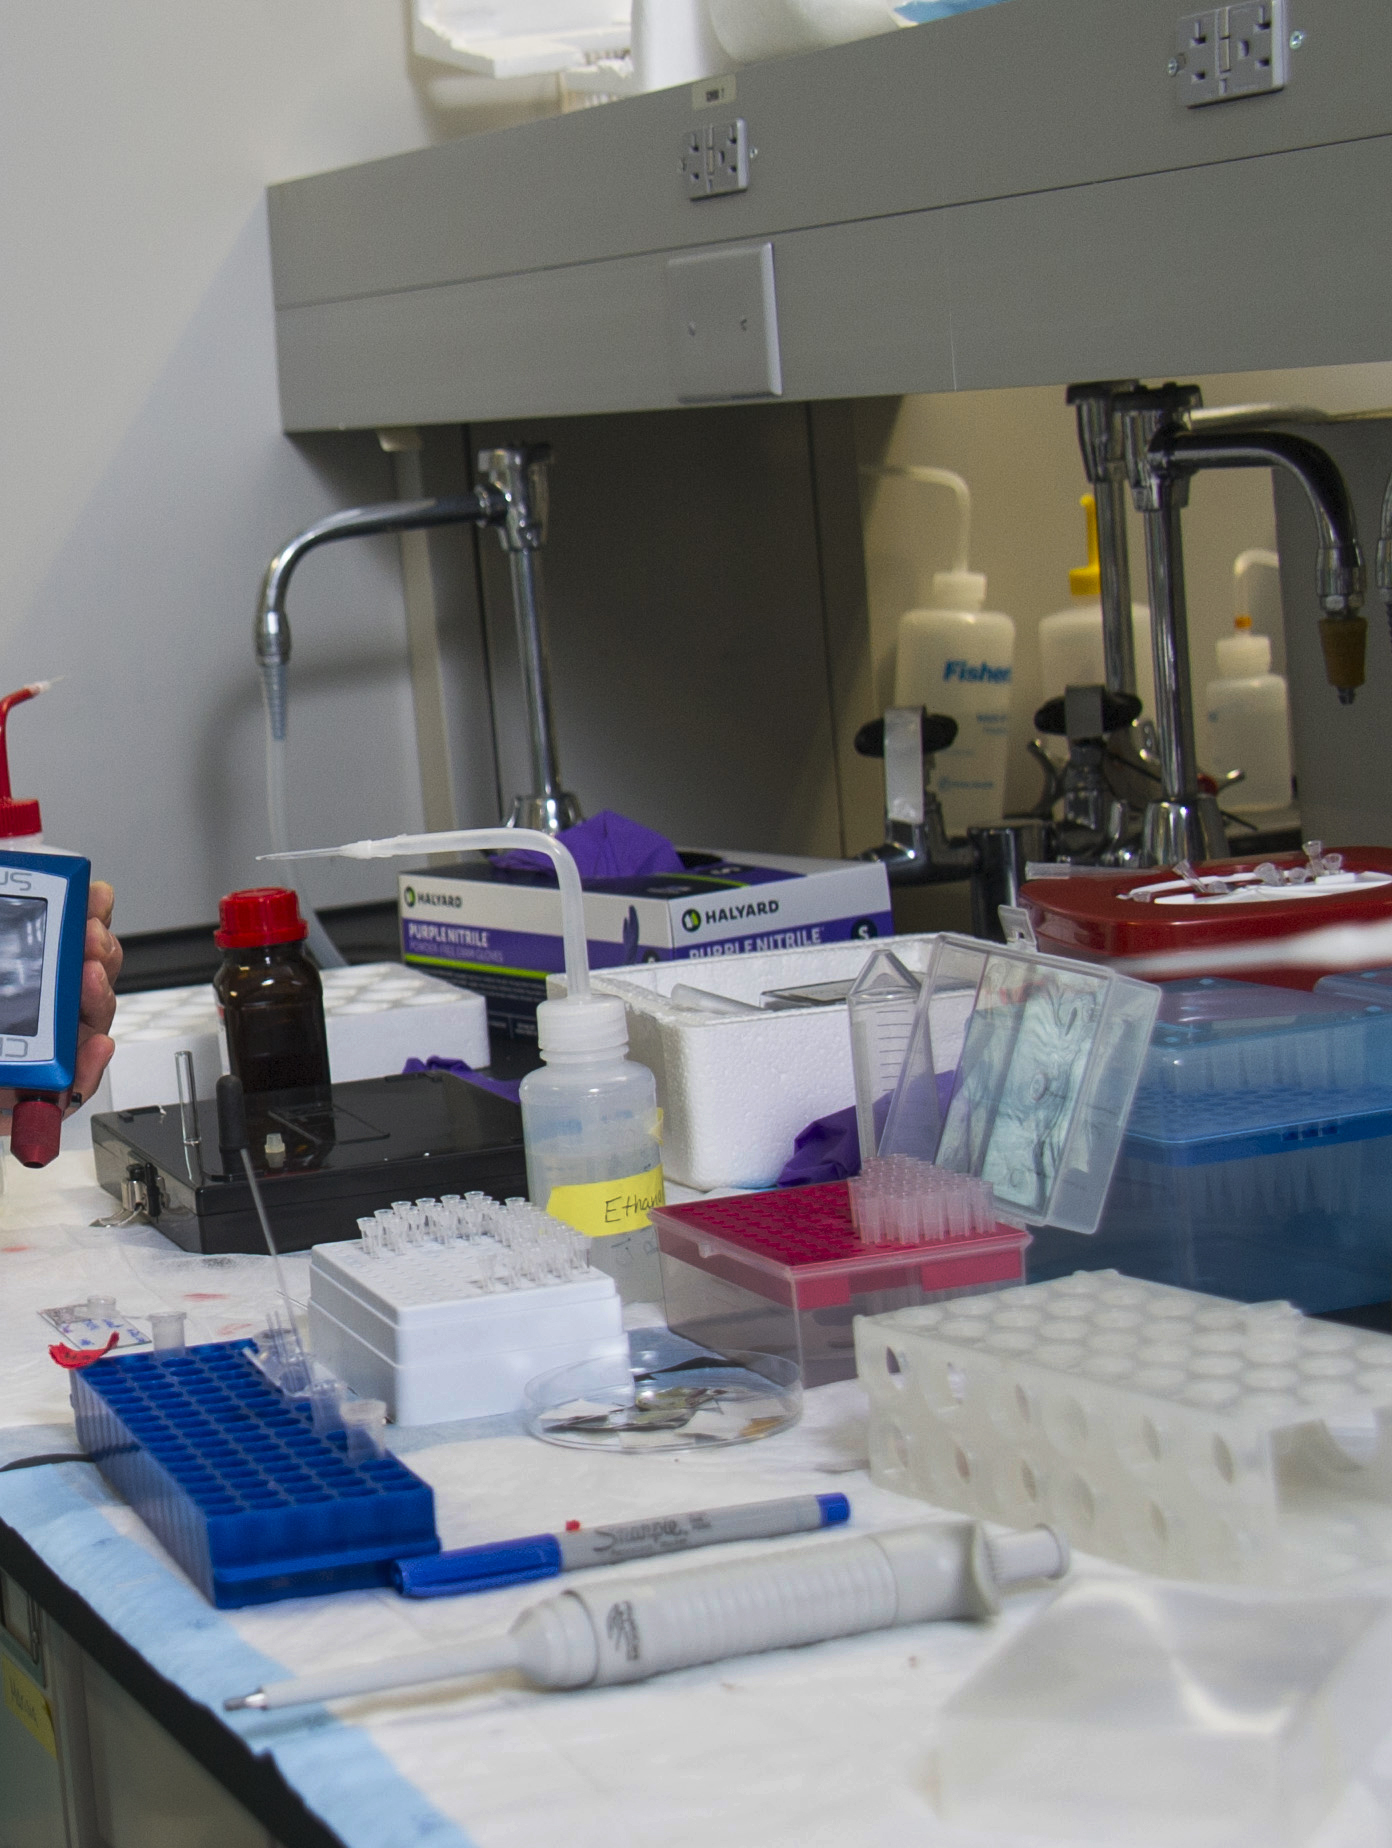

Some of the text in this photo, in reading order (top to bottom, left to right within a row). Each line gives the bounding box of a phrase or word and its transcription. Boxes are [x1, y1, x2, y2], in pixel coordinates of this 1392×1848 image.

[417, 892, 462, 908] HALYARD
[705, 899, 779, 924] HALYARD
[408, 923, 488, 948] PURPLE NITRILE
[756, 927, 821, 952] NITRILE
